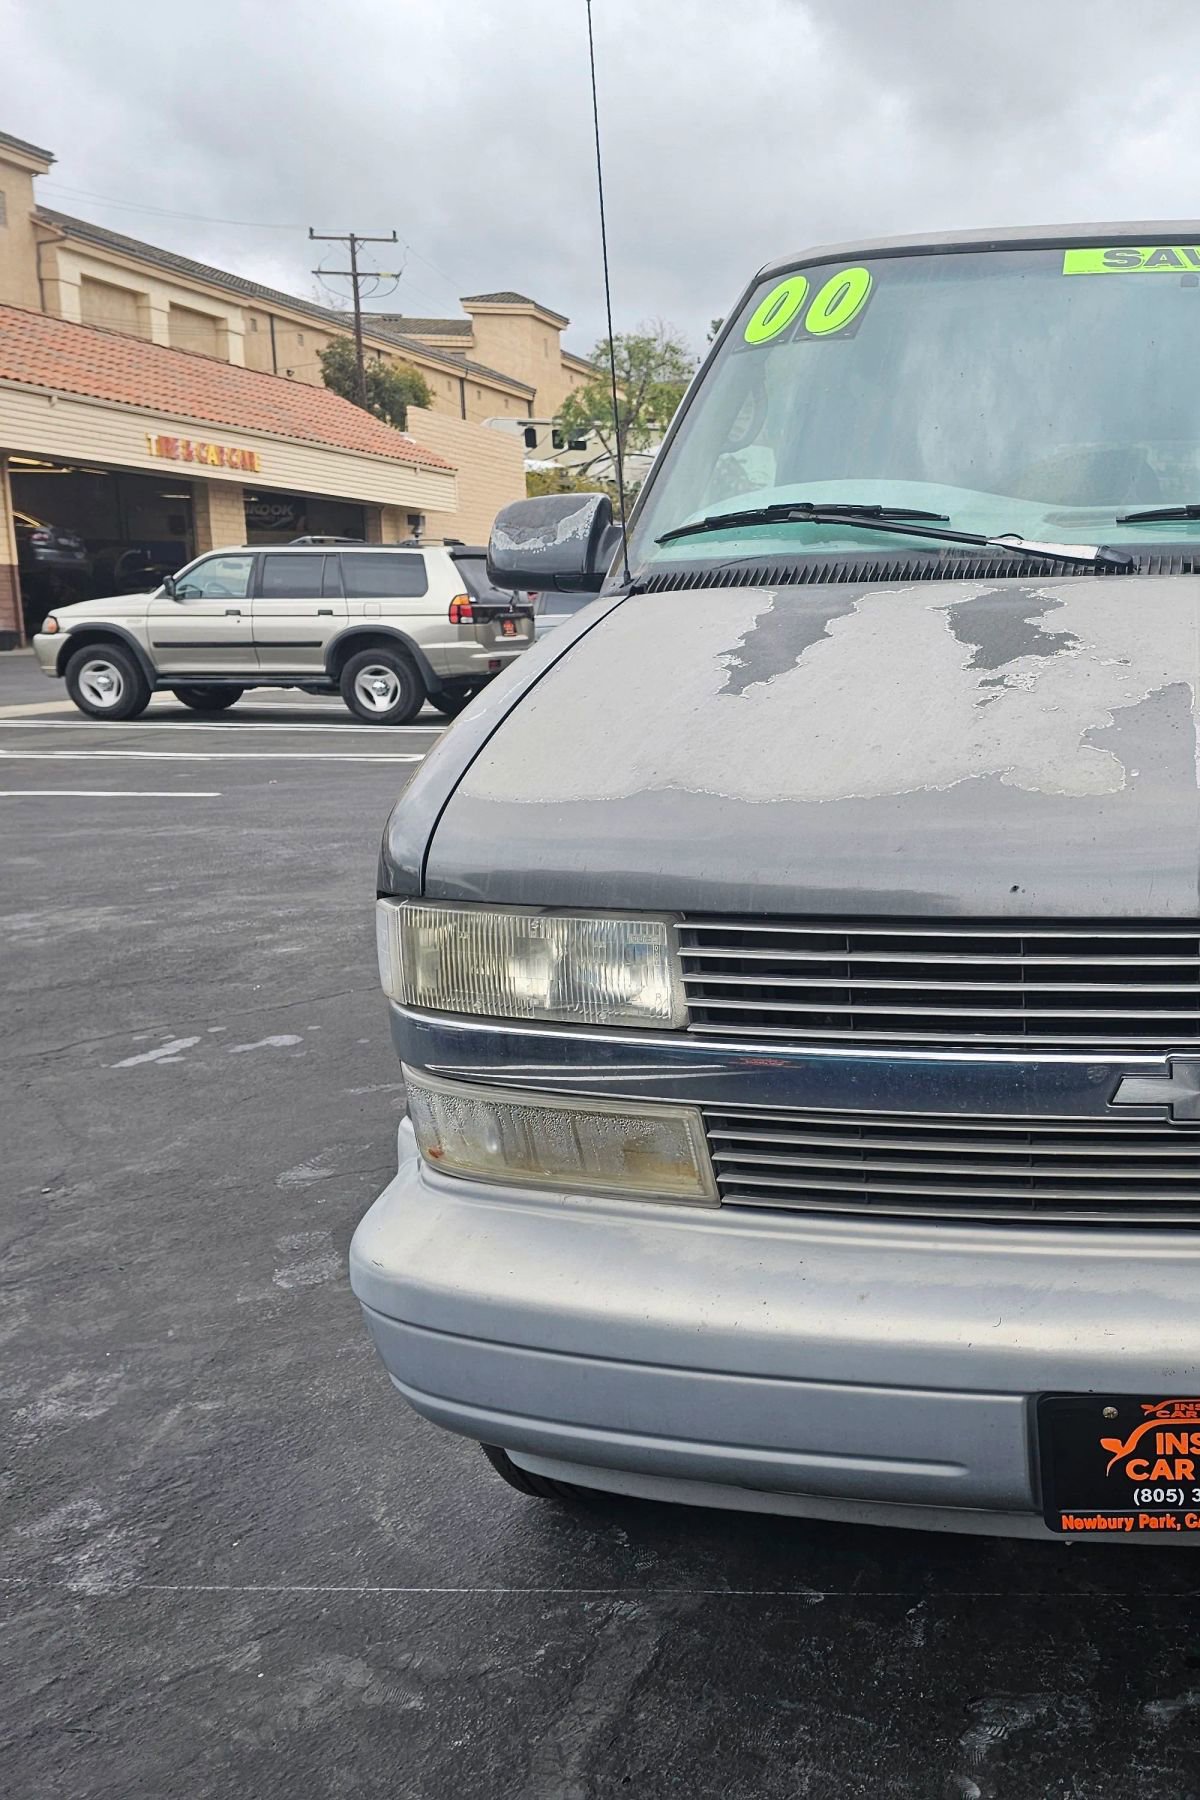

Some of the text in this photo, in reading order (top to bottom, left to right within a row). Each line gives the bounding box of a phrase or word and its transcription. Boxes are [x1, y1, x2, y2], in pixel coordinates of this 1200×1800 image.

[744, 267, 873, 345] 00
[1155, 1410, 1198, 1418] CAR
[1125, 1458, 1196, 1481] CAR
[1133, 1488, 1185, 1506] (805)
[1061, 1514, 1134, 1532] Newbury
[1138, 1513, 1181, 1531] Park,
